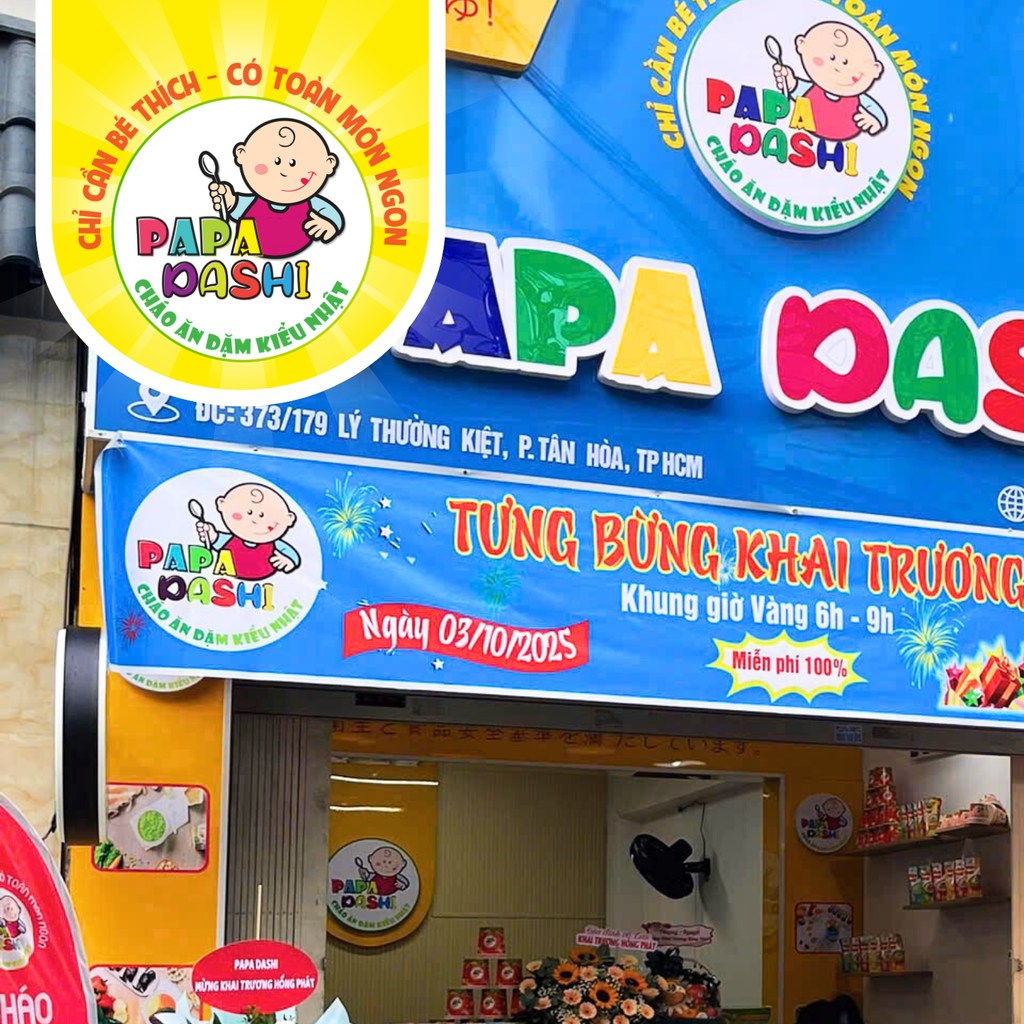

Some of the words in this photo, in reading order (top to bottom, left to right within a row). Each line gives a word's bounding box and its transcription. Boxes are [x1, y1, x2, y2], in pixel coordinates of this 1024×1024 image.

[666, 0, 697, 40] BÉ
[829, 0, 899, 46] OÀN
[643, 35, 678, 97] CẦN
[891, 49, 931, 113] MÓN
[646, 101, 685, 150] CHỈ
[706, 77, 817, 133] PAPA
[729, 122, 859, 178] DASHI
[897, 123, 932, 202] NGON
[706, 135, 743, 184] CHÁO
[741, 178, 766, 205] ĂN
[767, 197, 808, 221] DẶM
[811, 196, 853, 222] KIỂU
[852, 168, 891, 215] NHẬT
[400, 232, 720, 396] APA
[240, 405, 328, 437] 373/179
[338, 409, 361, 440] LÝ
[370, 416, 450, 452] THƯỜNG
[461, 426, 508, 461] KIỆT,
[538, 434, 576, 465] TÂN
[586, 439, 630, 474] HÒA,
[661, 451, 703, 480] HCM
[137, 538, 237, 576] PAPA
[446, 494, 580, 573] TƯNG
[592, 509, 723, 586] BỪNG
[733, 525, 852, 594] KHAI
[136, 582, 169, 622] CHÁO
[167, 609, 191, 636] ĂN
[192, 625, 229, 648] DẶM
[231, 617, 272, 647] KIỂU
[269, 598, 304, 639] NHẬT
[158, 574, 275, 612] DASHI
[621, 582, 699, 623] Khung
[706, 592, 745, 624] giờ
[750, 592, 809, 631] Vàng
[815, 602, 843, 630] 6h
[866, 605, 894, 635] 9h
[362, 606, 430, 653] Ngày
[438, 614, 578, 665] 03/10/2025
[732, 648, 770, 673] Miễn
[773, 650, 800, 678] phí
[804, 655, 848, 680] 100%
[220, 980, 239, 991] KHAI
[240, 979, 273, 990] TRƯƠNG
[296, 975, 315, 988] PHÁT
[234, 959, 255, 970] PAPA
[255, 959, 279, 970] DASHI
